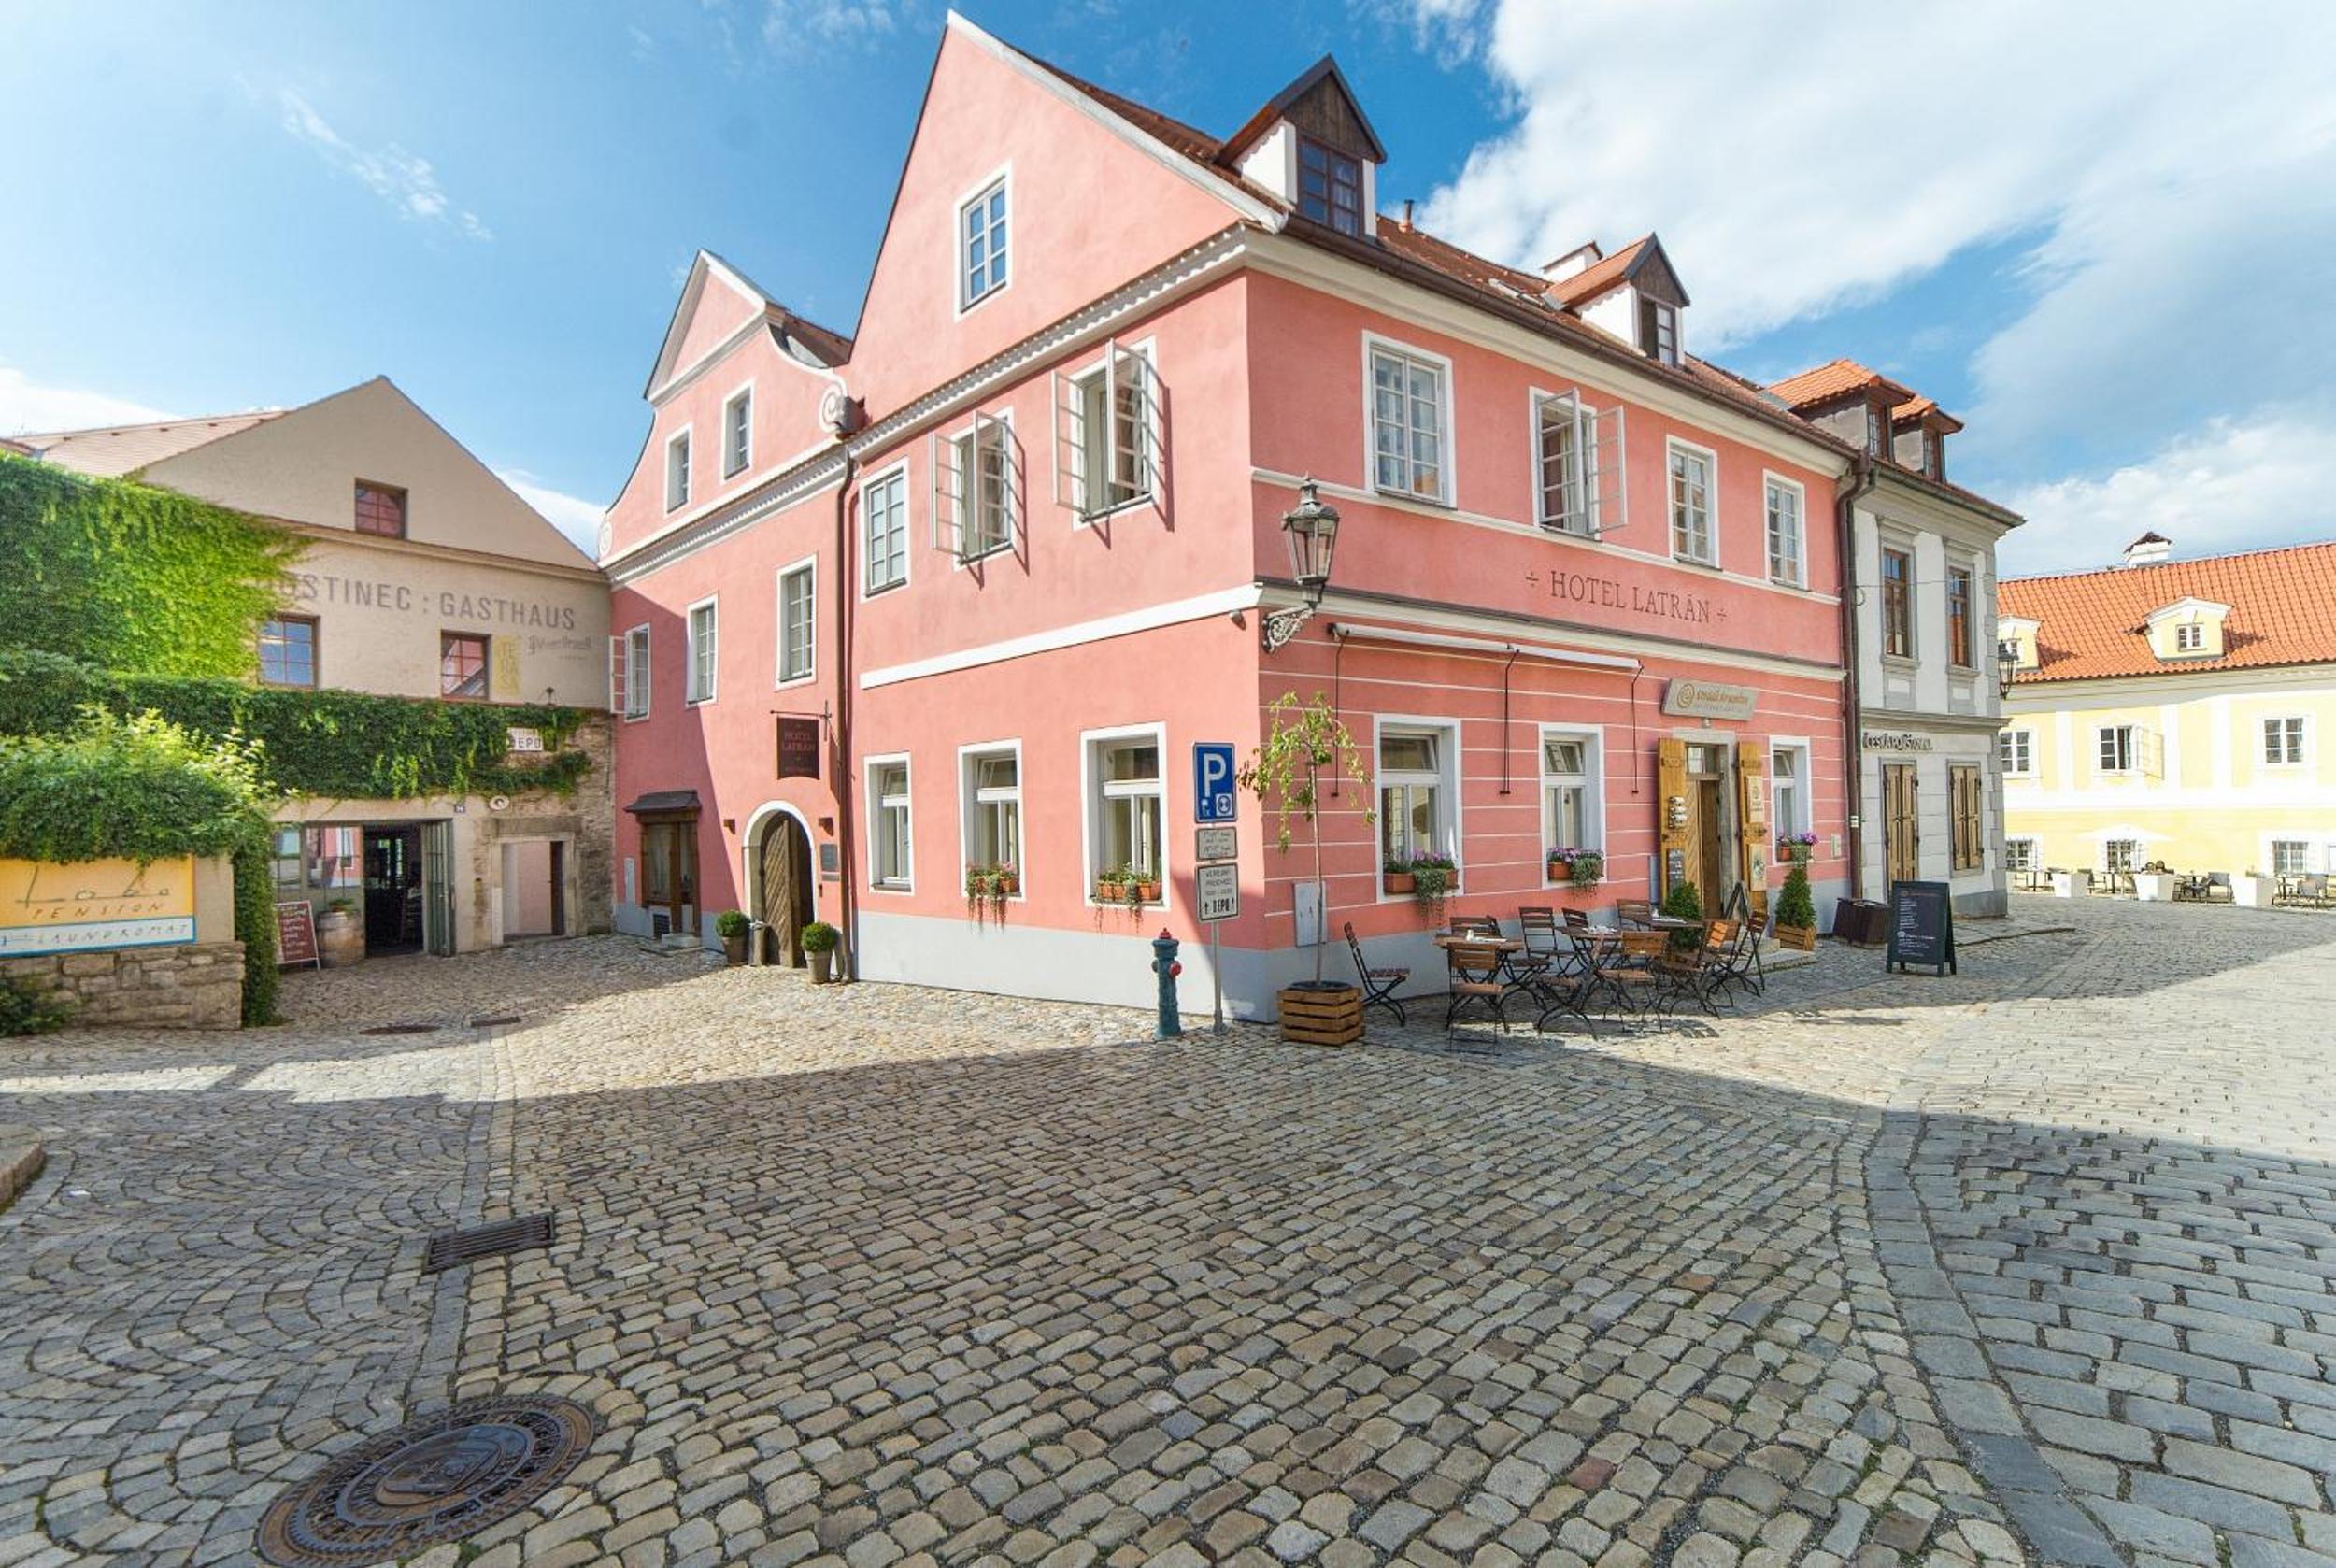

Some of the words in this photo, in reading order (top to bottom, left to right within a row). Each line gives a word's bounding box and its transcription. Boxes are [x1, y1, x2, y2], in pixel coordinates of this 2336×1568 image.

[254, 567, 411, 610] OSTINEC
[440, 592, 576, 631] GASTHAUS
[1550, 571, 1626, 609] HOTEL
[1203, 752, 1227, 798] P
